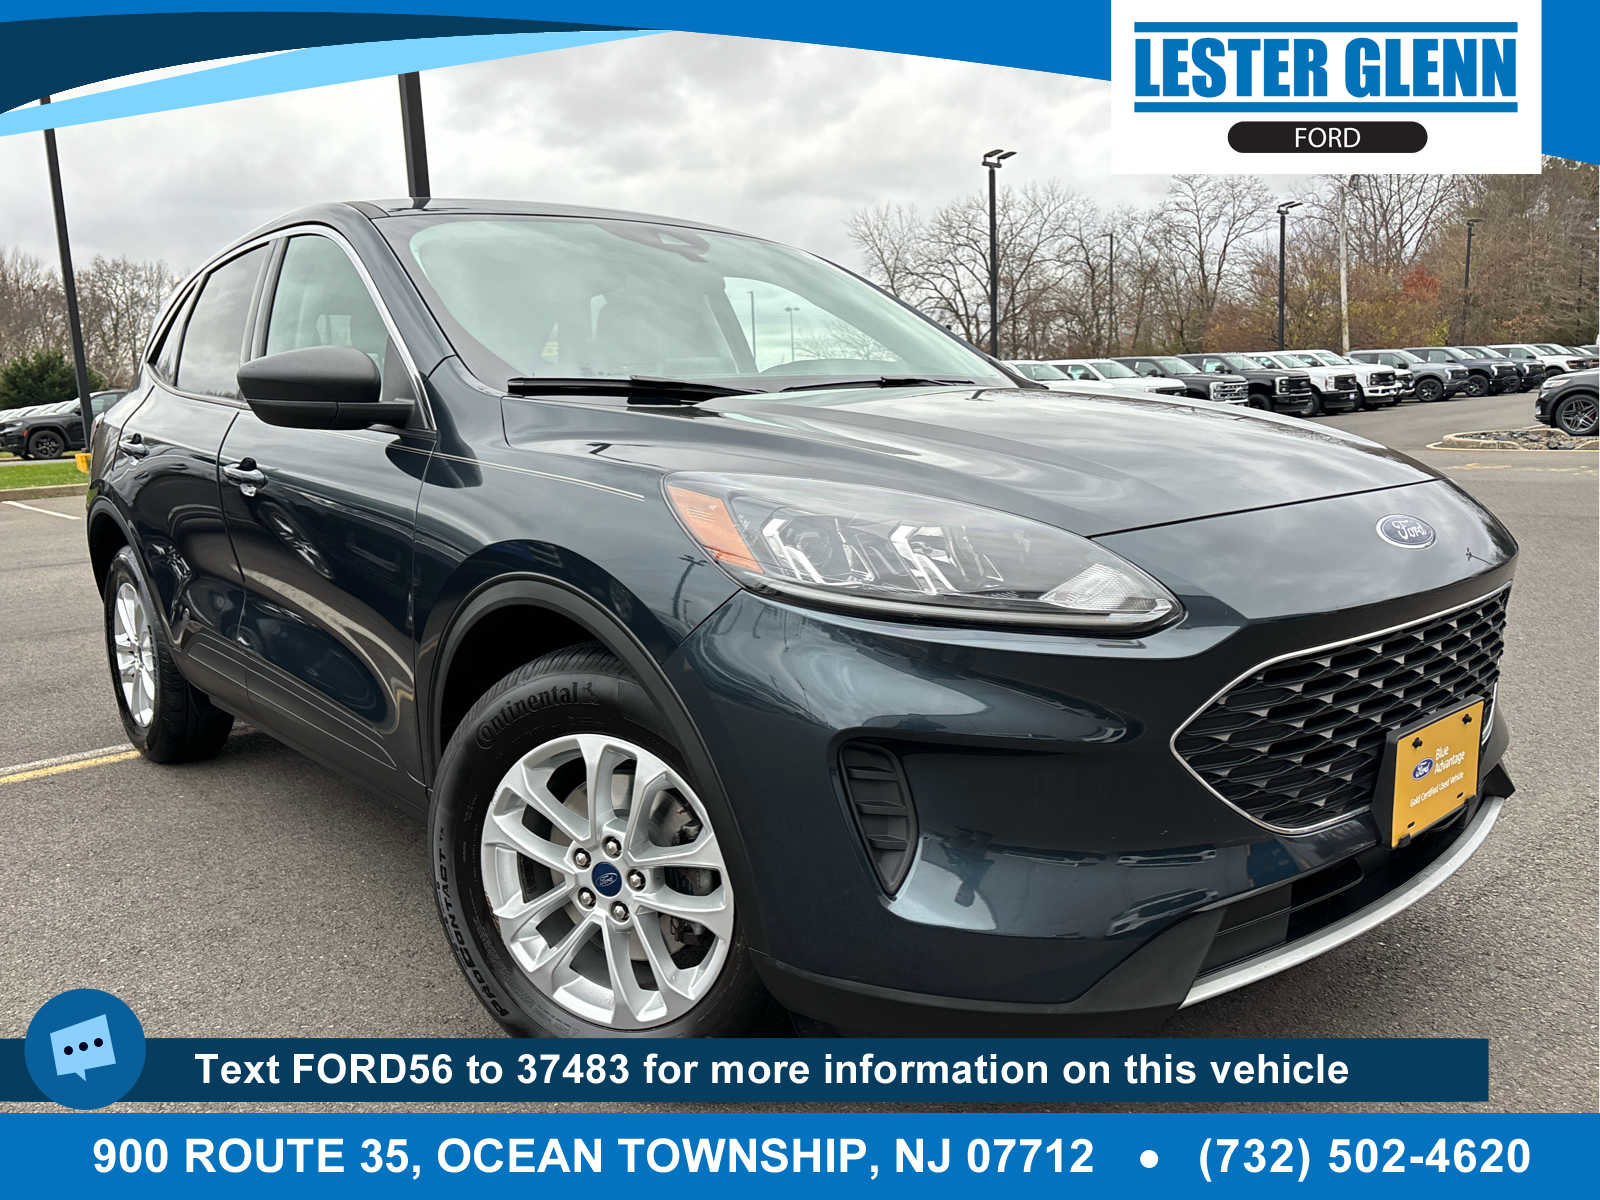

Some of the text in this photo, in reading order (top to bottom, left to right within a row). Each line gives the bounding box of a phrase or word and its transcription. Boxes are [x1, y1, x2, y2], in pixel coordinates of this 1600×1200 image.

[1391, 519, 1428, 540] Ford
[477, 682, 578, 750] Continental
[1434, 751, 1465, 775] Advantage
[1435, 746, 1449, 760] Blue
[1421, 783, 1439, 801] Certified
